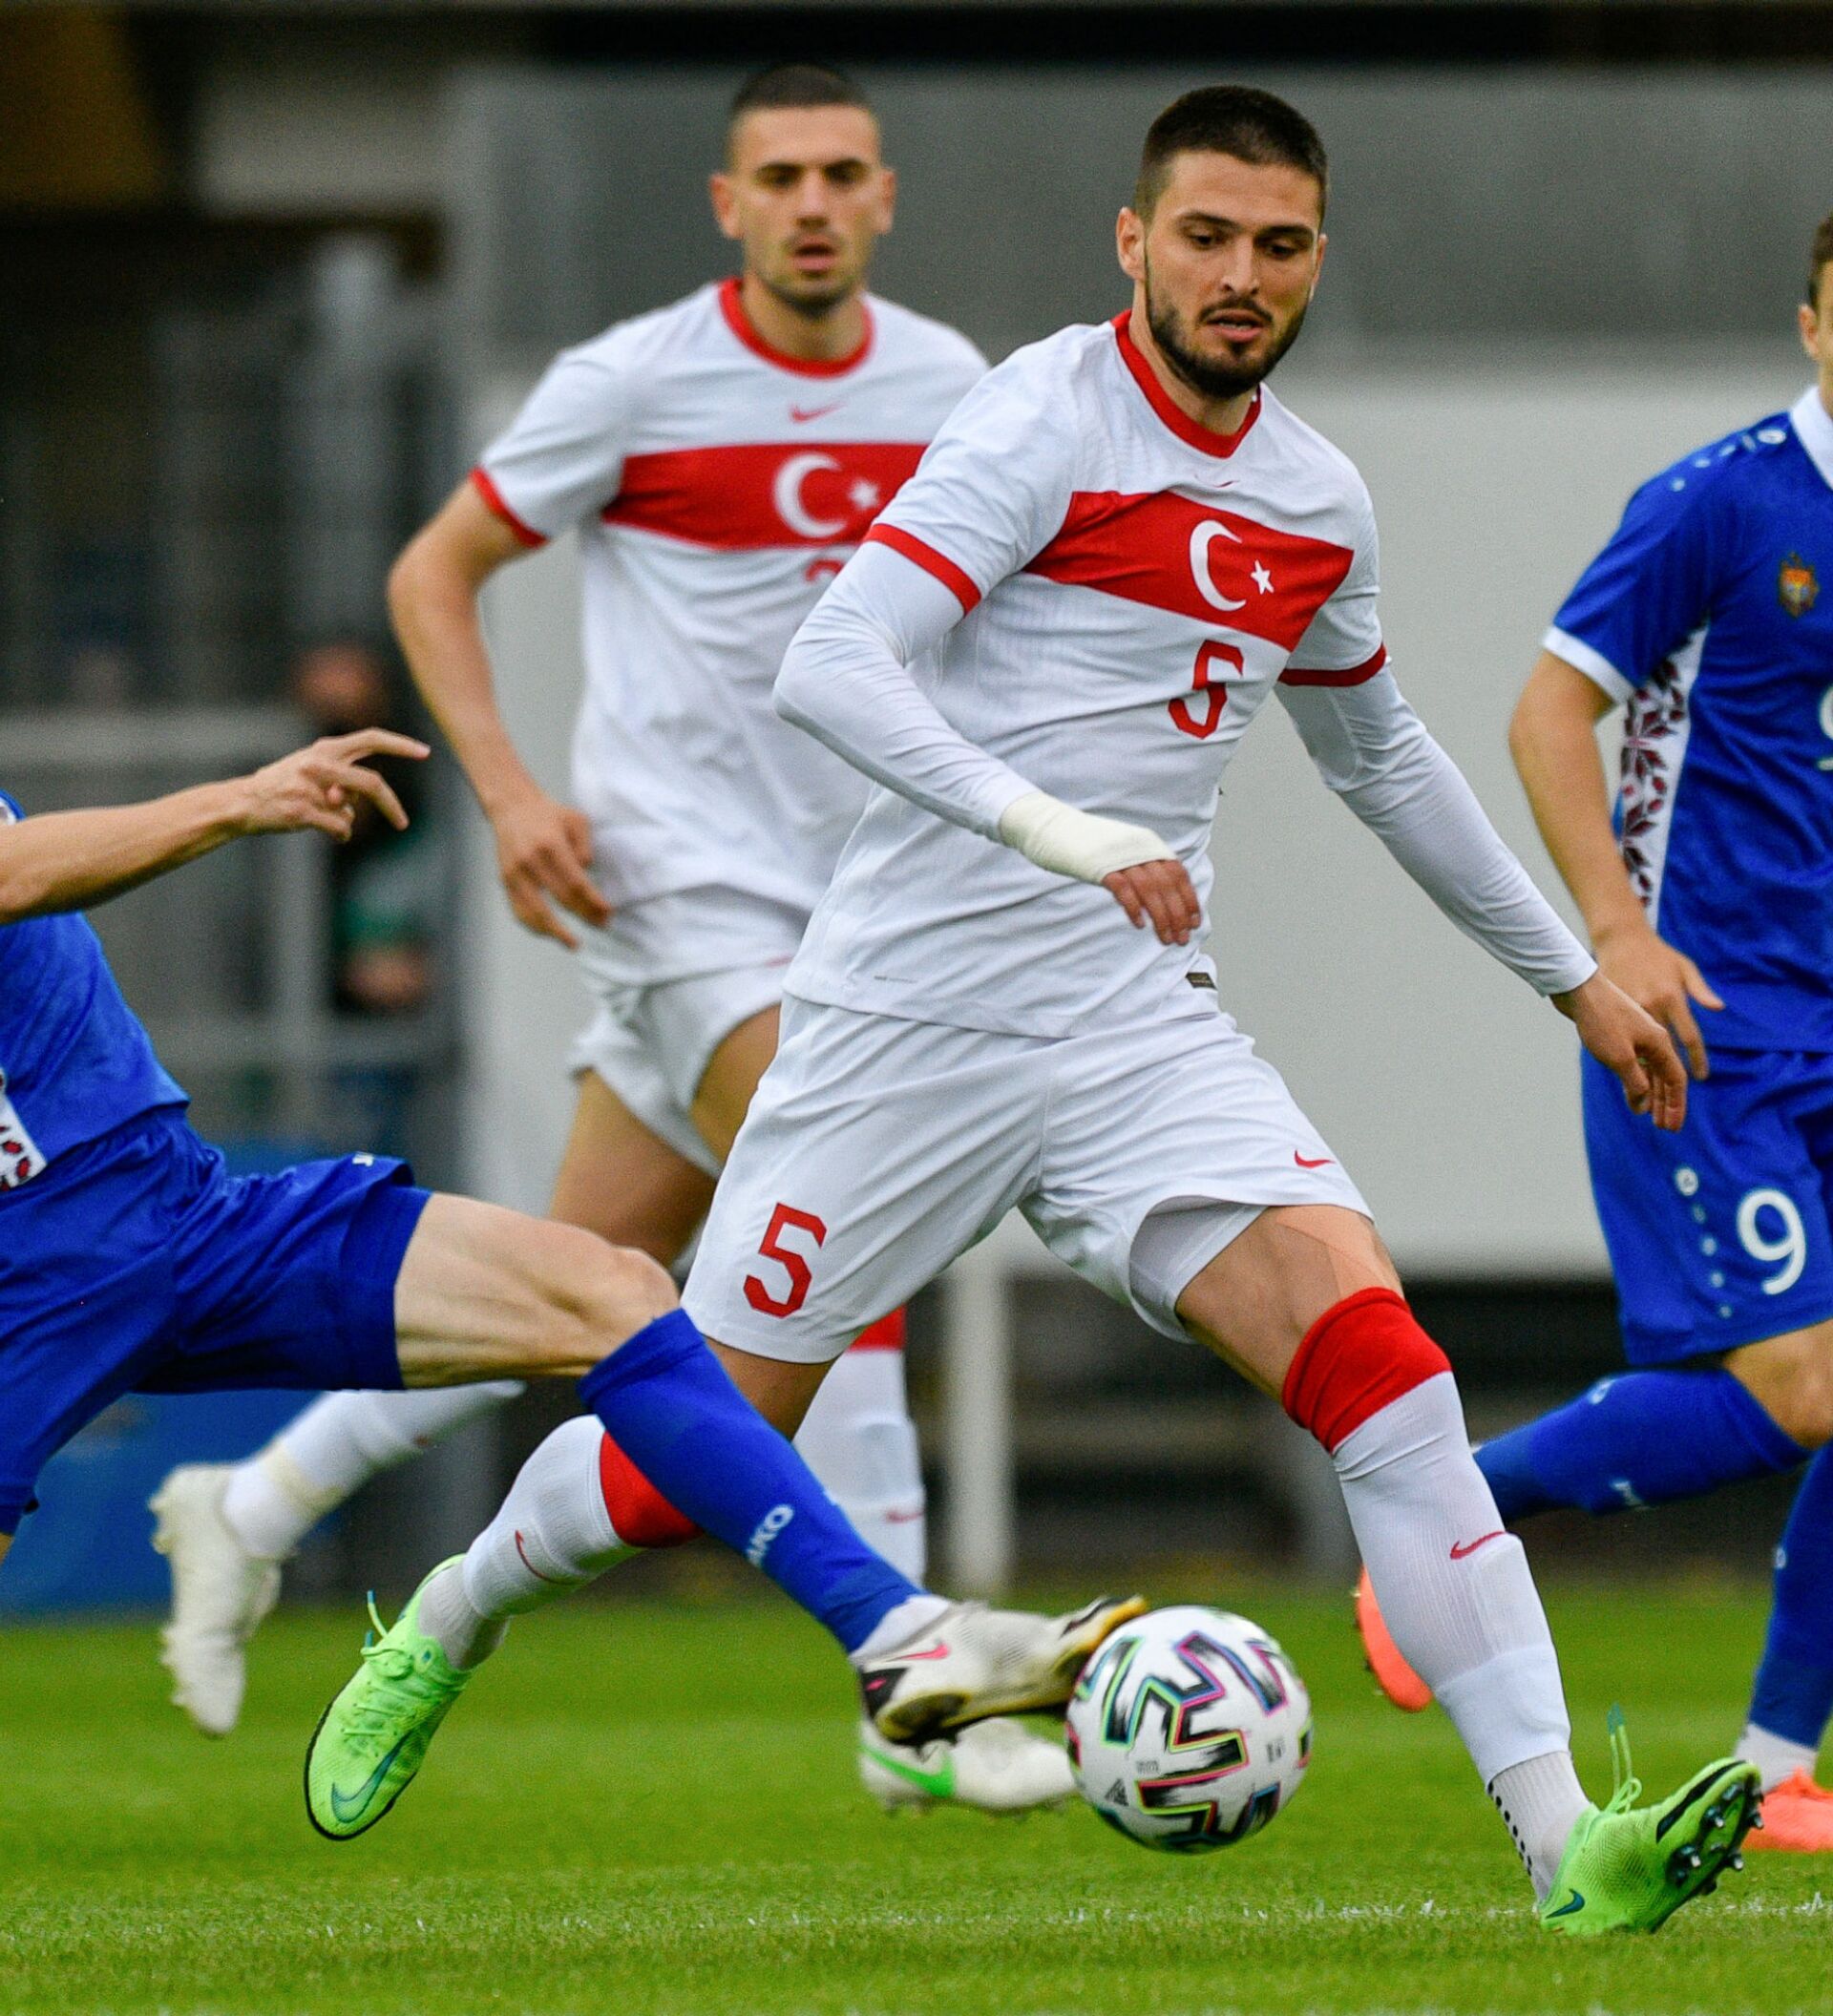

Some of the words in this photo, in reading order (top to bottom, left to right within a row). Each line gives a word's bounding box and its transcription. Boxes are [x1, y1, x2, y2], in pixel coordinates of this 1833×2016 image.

[1168, 639, 1244, 740] 5
[743, 1202, 828, 1319] 5
[1737, 1188, 1806, 1295] 9
